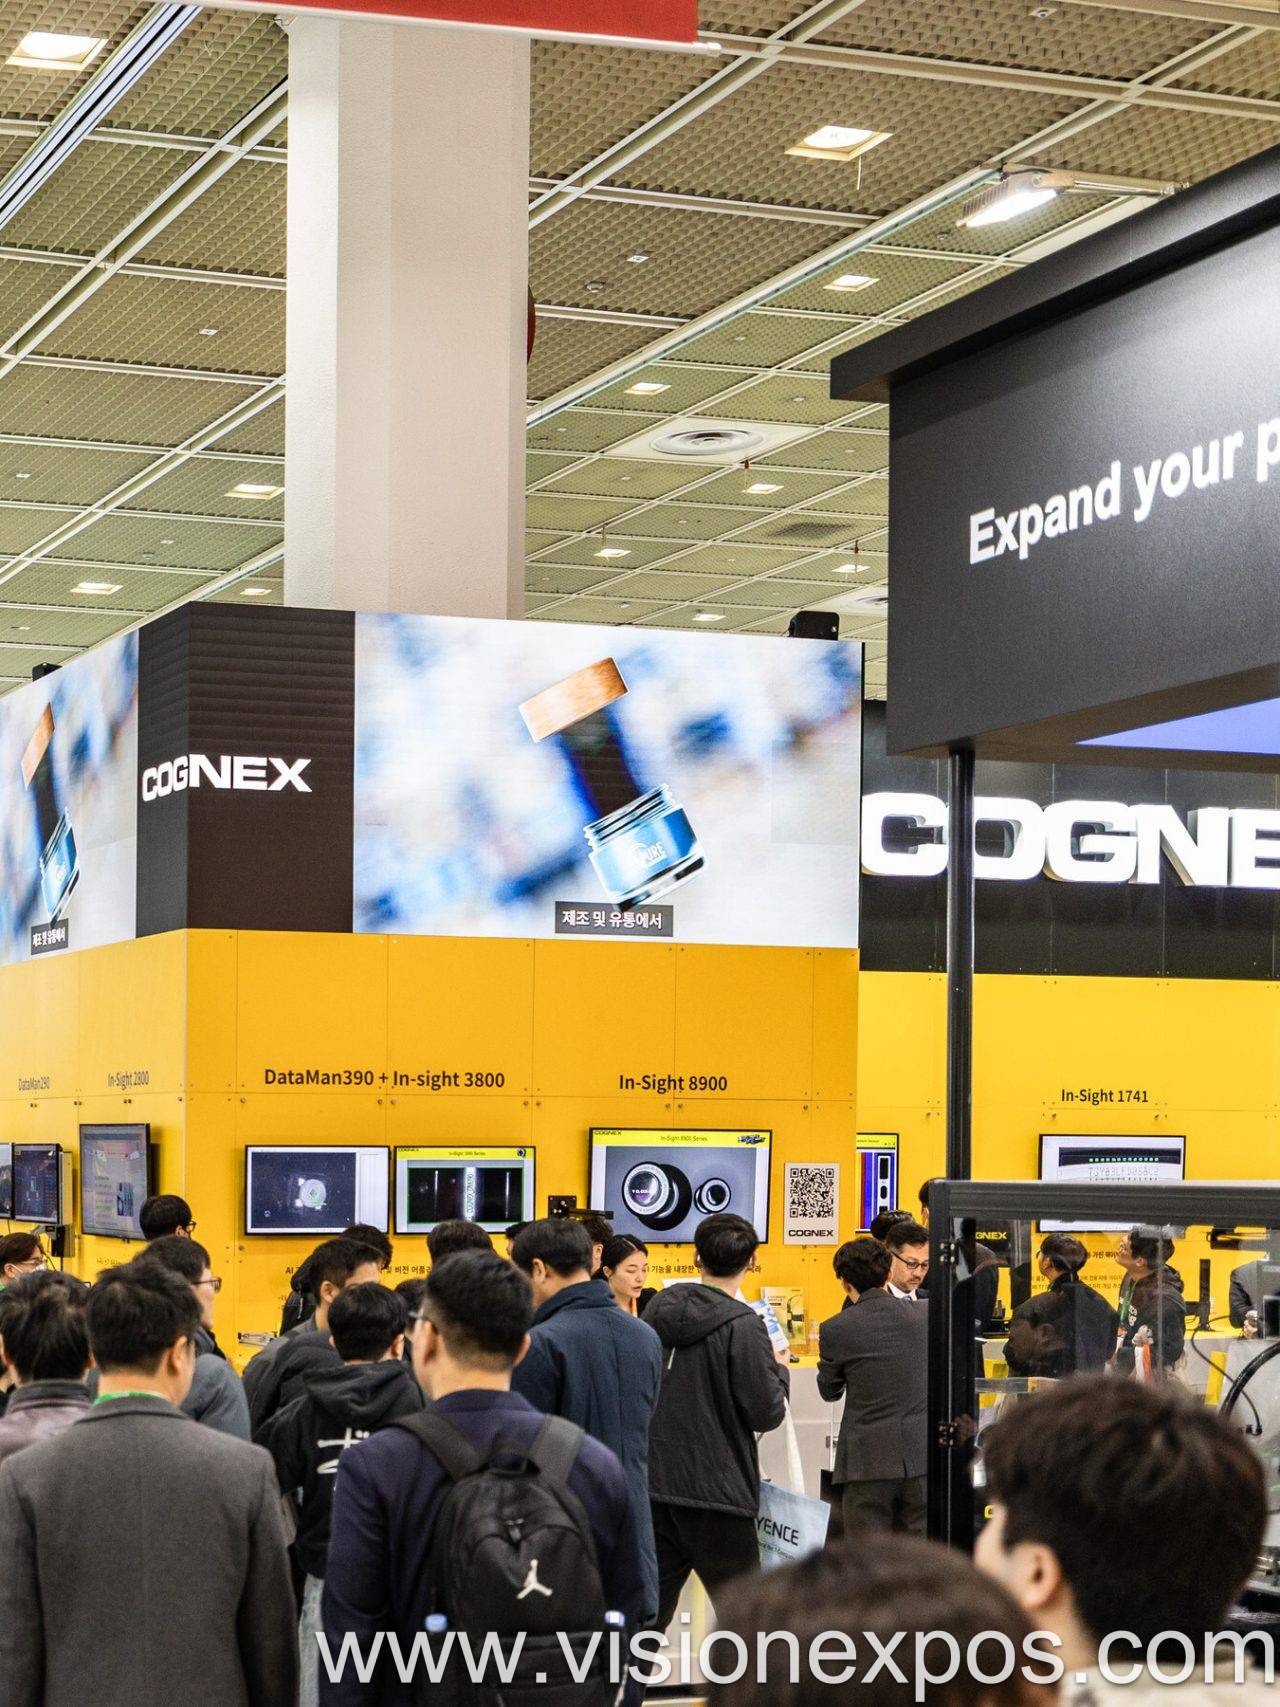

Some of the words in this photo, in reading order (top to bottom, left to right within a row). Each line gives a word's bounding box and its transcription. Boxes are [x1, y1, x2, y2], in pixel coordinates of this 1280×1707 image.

[969, 460, 1121, 566] Expand
[1132, 430, 1244, 523] your
[141, 753, 313, 802] COGNEX
[562, 910, 590, 927] 제조
[593, 911, 606, 927] 및
[609, 911, 663, 930] 유통에서
[18, 1076, 50, 1091] DataMan290
[107, 1072, 133, 1091] In-Sight
[133, 1071, 150, 1086] 2800
[264, 1069, 374, 1086] DataMan390
[378, 1072, 389, 1084] +
[393, 1070, 460, 1091] In-sight
[464, 1072, 505, 1088] 3800
[619, 1073, 685, 1095] In-Sight
[688, 1076, 728, 1091] 8900
[1061, 1088, 1114, 1106] In-Sight
[1117, 1090, 1149, 1103] 1741
[788, 1229, 834, 1237] COGNEX
